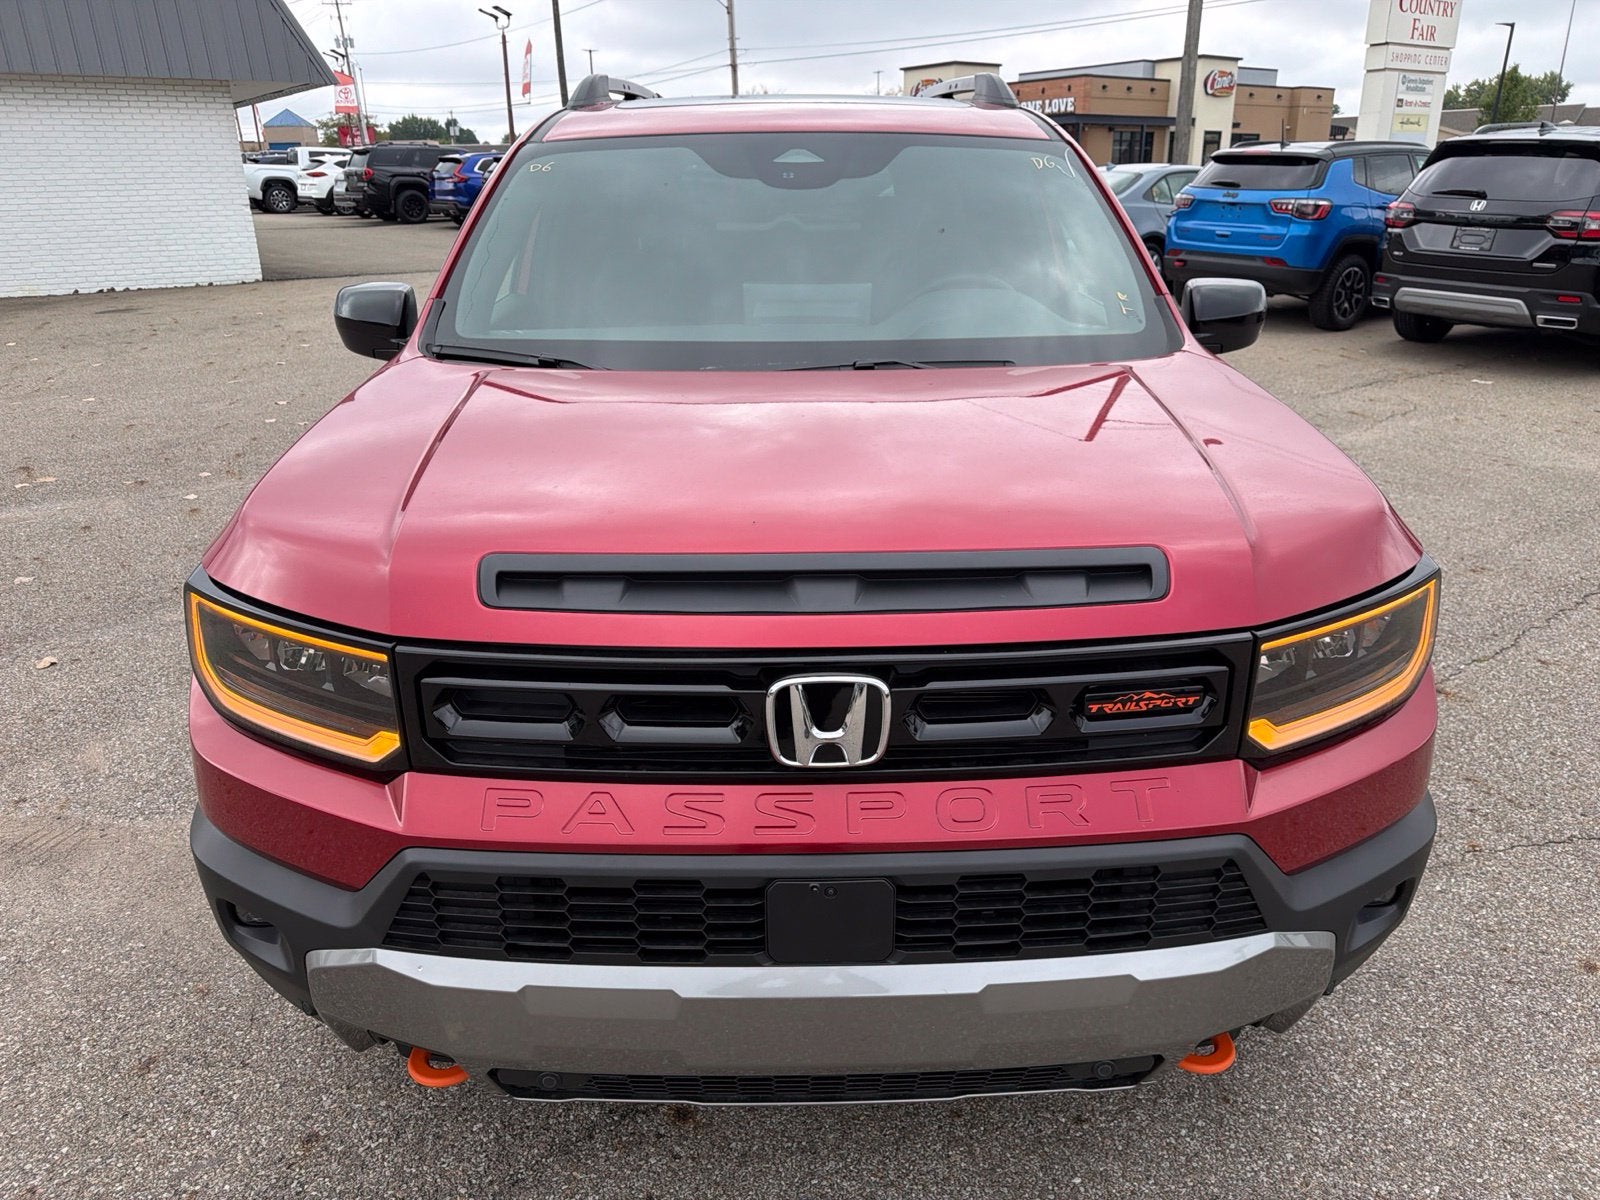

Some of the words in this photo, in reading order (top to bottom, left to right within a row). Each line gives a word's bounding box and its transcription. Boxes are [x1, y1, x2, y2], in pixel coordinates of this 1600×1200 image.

[1399, 0, 1456, 18] COUNTRY
[1410, 18, 1437, 42] FAIR
[1391, 51, 1422, 65] SHOPPING
[1424, 54, 1448, 66] CENTER
[1044, 97, 1075, 114] LOVE
[530, 161, 555, 172] D6
[1088, 696, 1200, 714] TRAILSPORT
[480, 777, 1171, 836] PASSPORT
